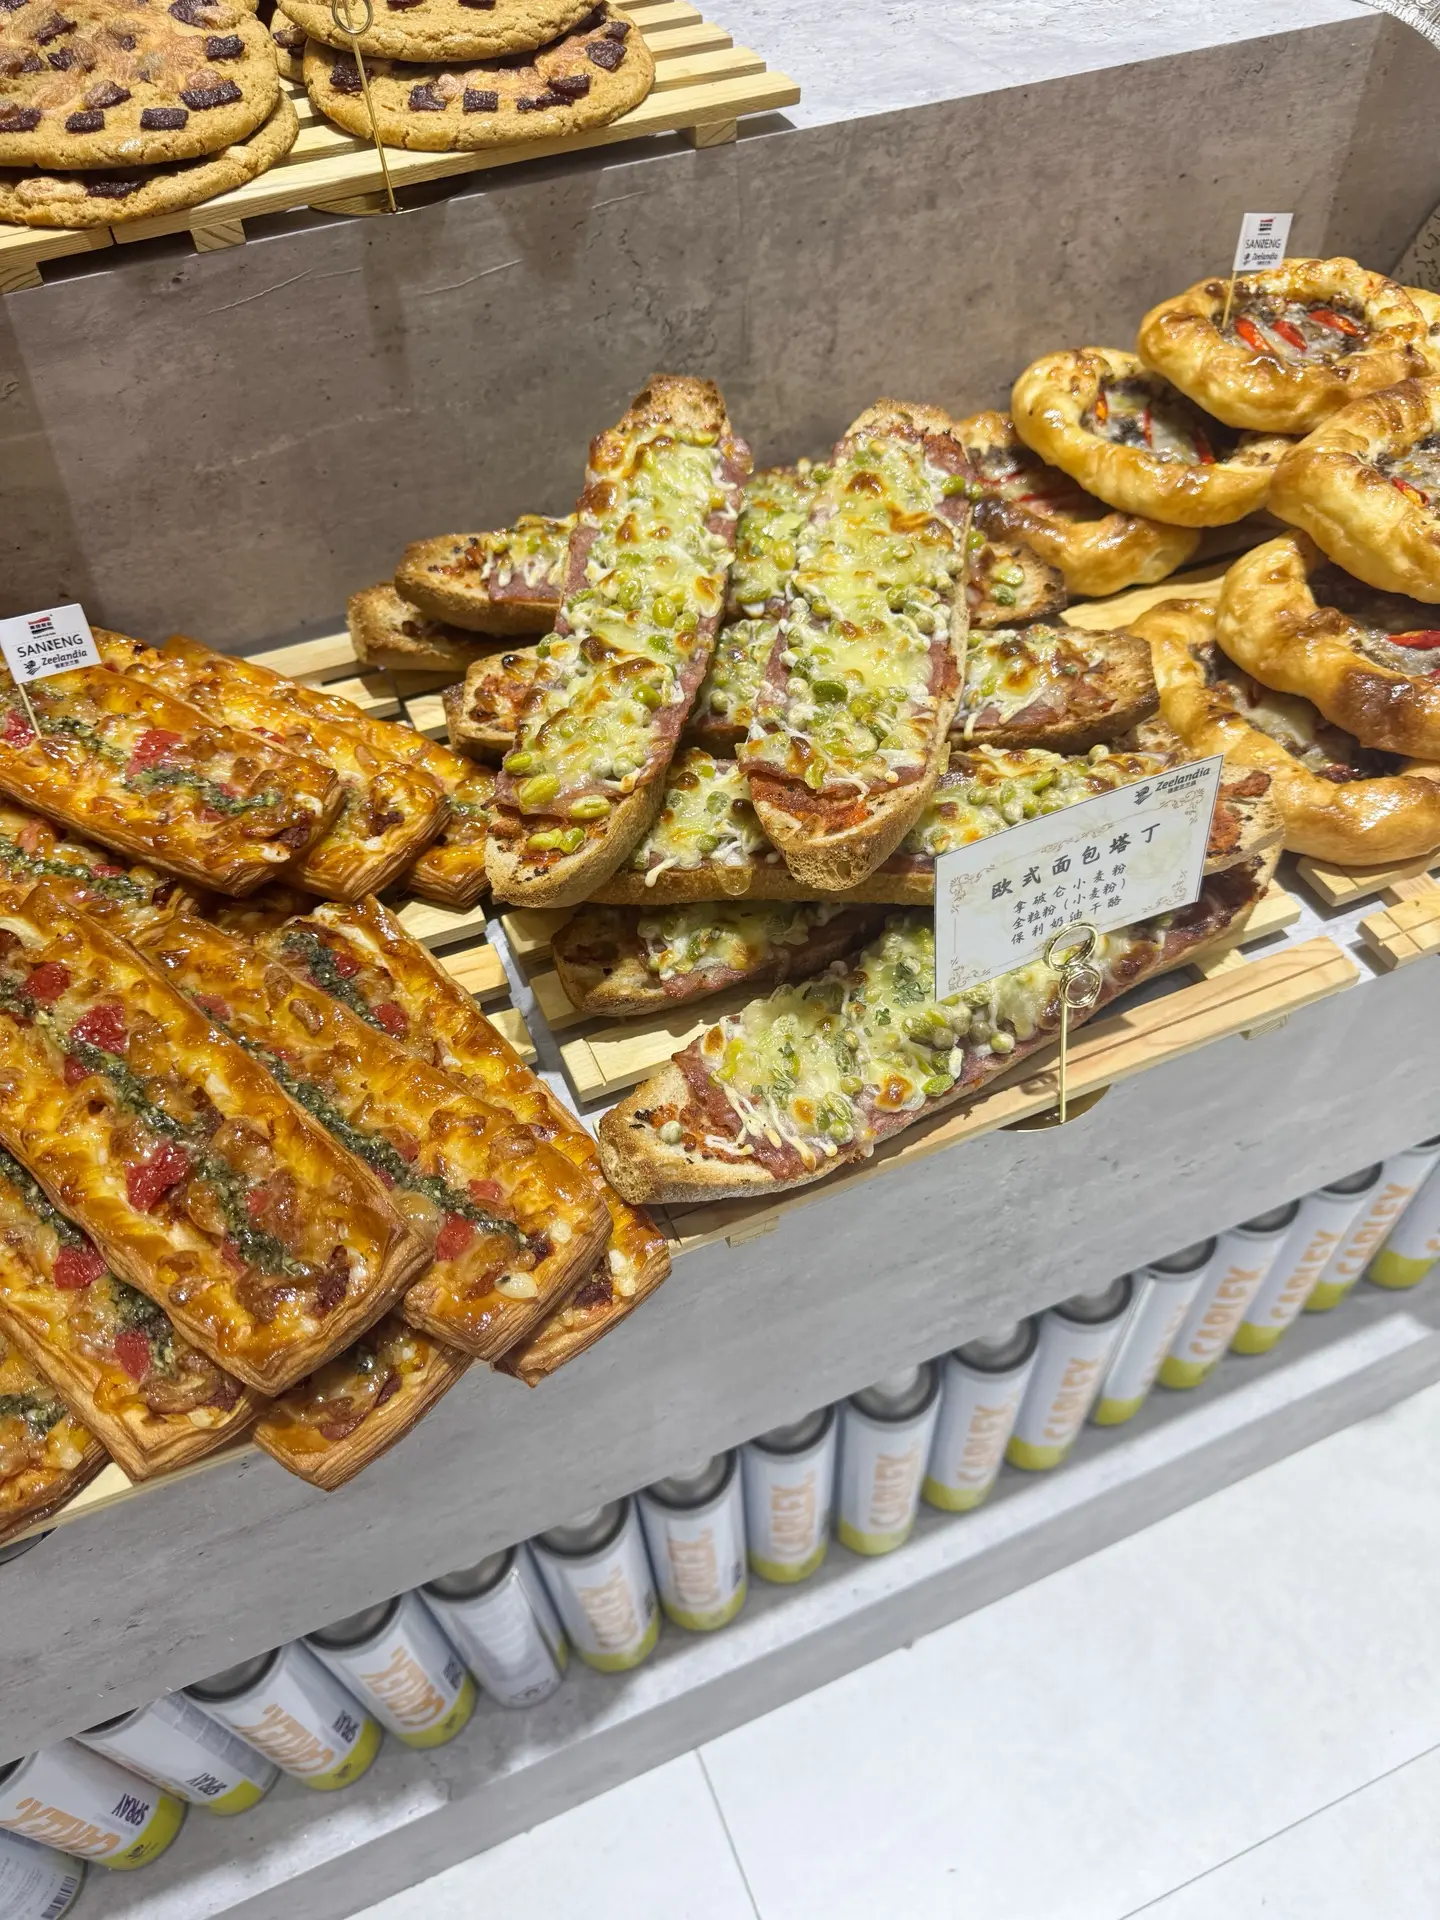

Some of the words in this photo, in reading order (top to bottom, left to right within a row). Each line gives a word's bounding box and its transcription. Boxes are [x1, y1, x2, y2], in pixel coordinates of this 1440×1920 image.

[41, 649, 88, 666] Zeelandia
[1155, 767, 1211, 791] Zeelandia
[991, 823, 1161, 900] 欧式面包塔丁
[1013, 863, 1127, 914] 拿破仑小麦粉
[1011, 896, 1122, 945] 保利奶油干酪
[186, 1772, 228, 1796] SPRAY
[111, 1793, 149, 1826] SPRAY
